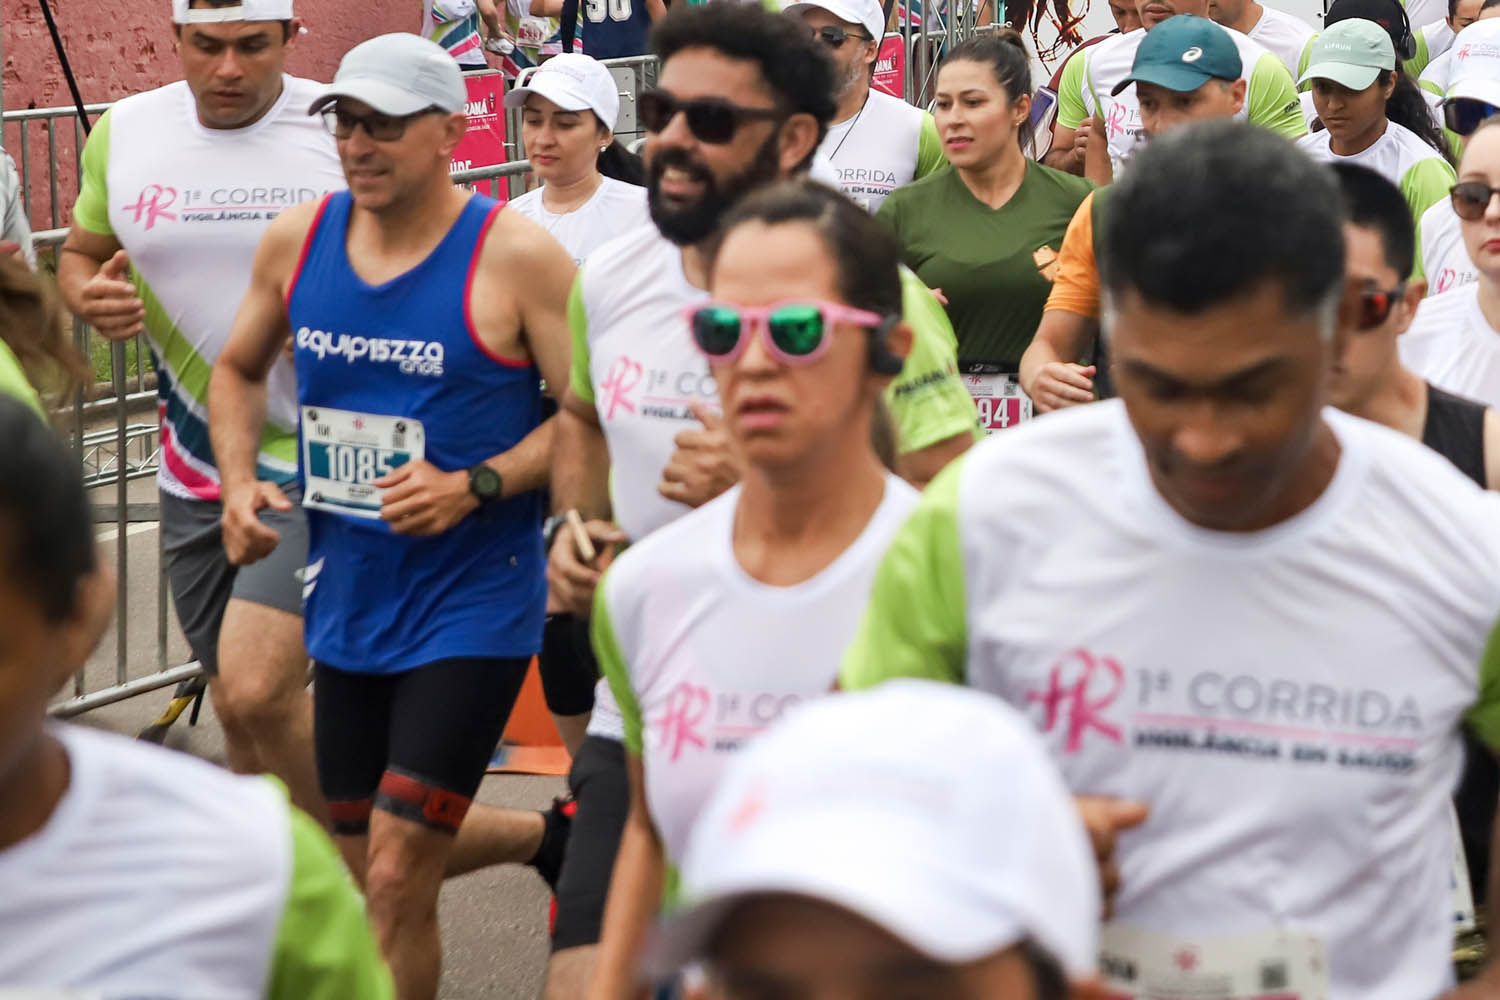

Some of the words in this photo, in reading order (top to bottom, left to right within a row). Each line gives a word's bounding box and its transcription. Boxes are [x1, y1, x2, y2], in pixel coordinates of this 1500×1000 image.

[210, 187, 329, 206] CORRID
[852, 186, 865, 194] EM
[1187, 671, 1423, 730] CORRIDA
